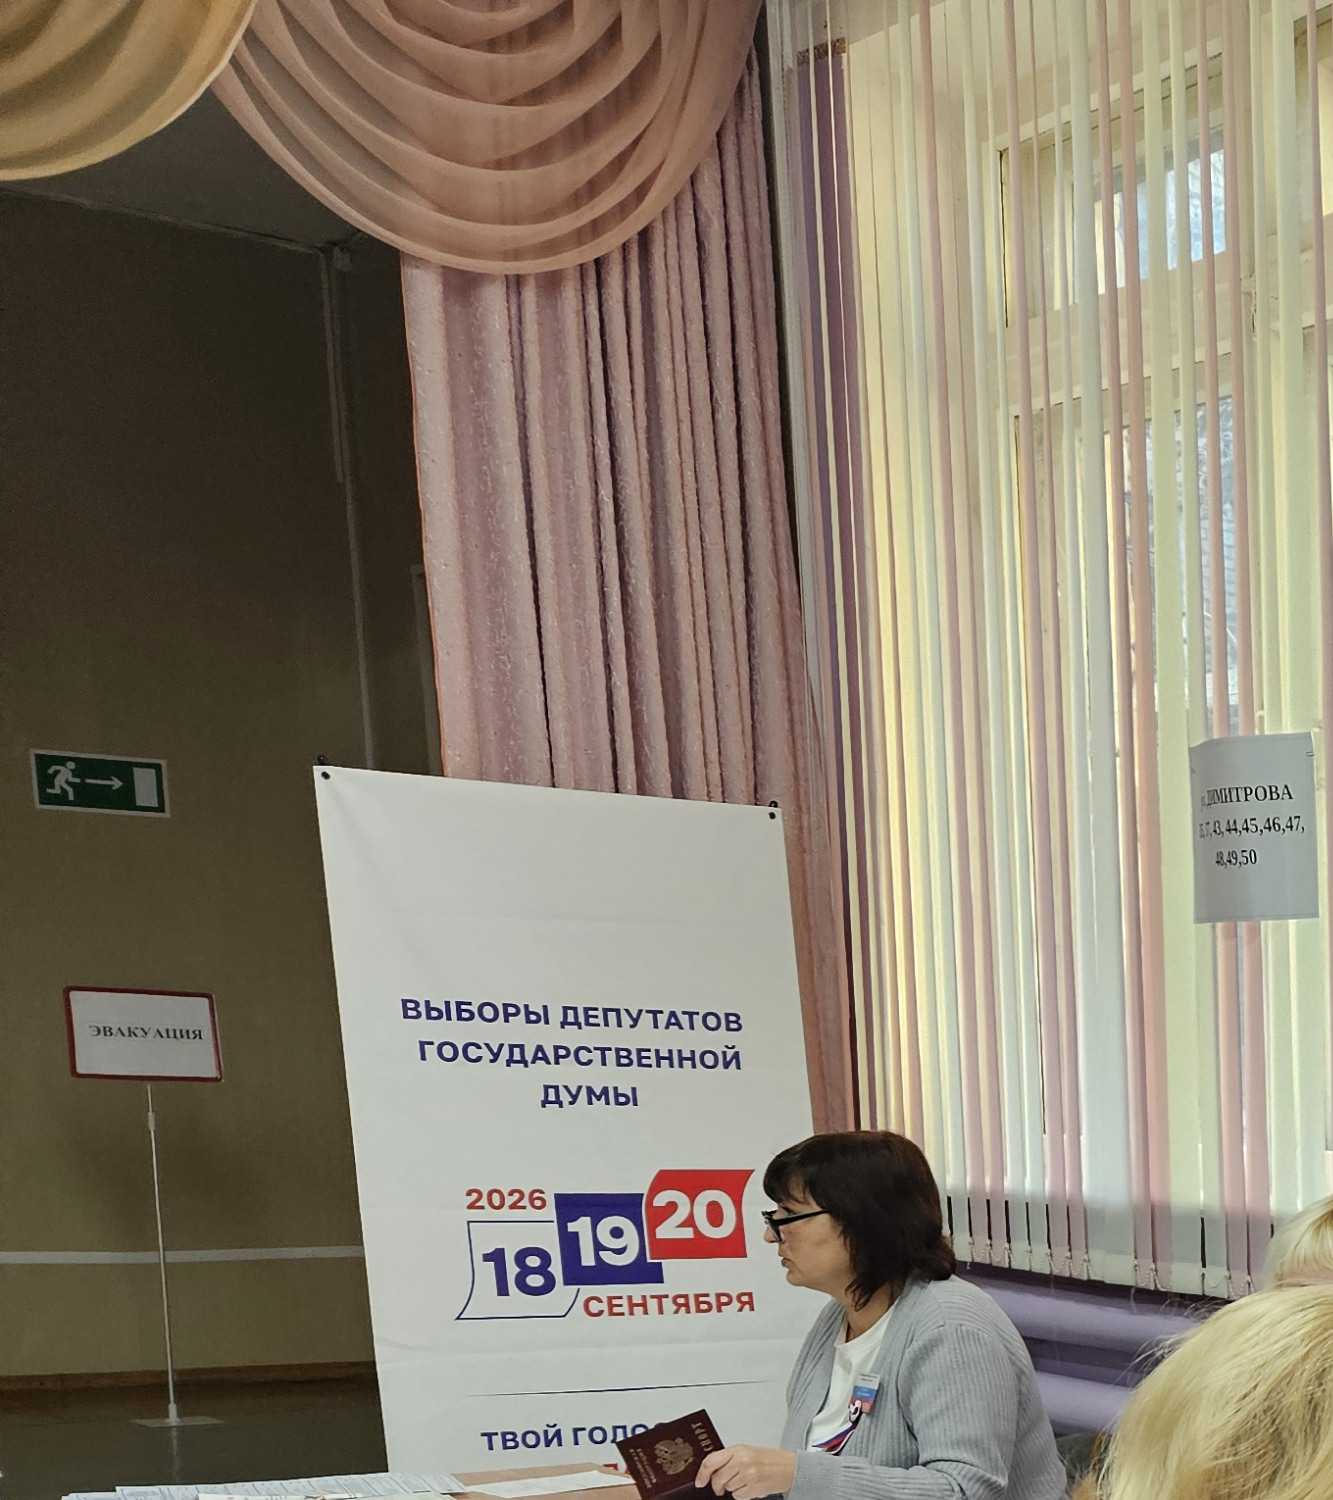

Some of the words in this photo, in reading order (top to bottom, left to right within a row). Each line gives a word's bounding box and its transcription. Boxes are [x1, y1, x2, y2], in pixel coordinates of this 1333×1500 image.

[401, 998, 550, 1025] ВЫБОРЫ
[559, 1004, 742, 1033] ДЕПУТАТОВ
[88, 1024, 203, 1041] ЭВАКУАЦИЯ
[418, 1040, 742, 1071] ГОСУДАРСТВЕННОЙ
[541, 1084, 639, 1108] ДУМЫ
[465, 1188, 547, 1211] 2026
[482, 1247, 557, 1297] 18
[566, 1214, 641, 1267] 19
[652, 1190, 737, 1240] 20
[583, 1292, 755, 1318] СЕНТЯБРЯ
[480, 1424, 563, 1451] ТВОЙ
